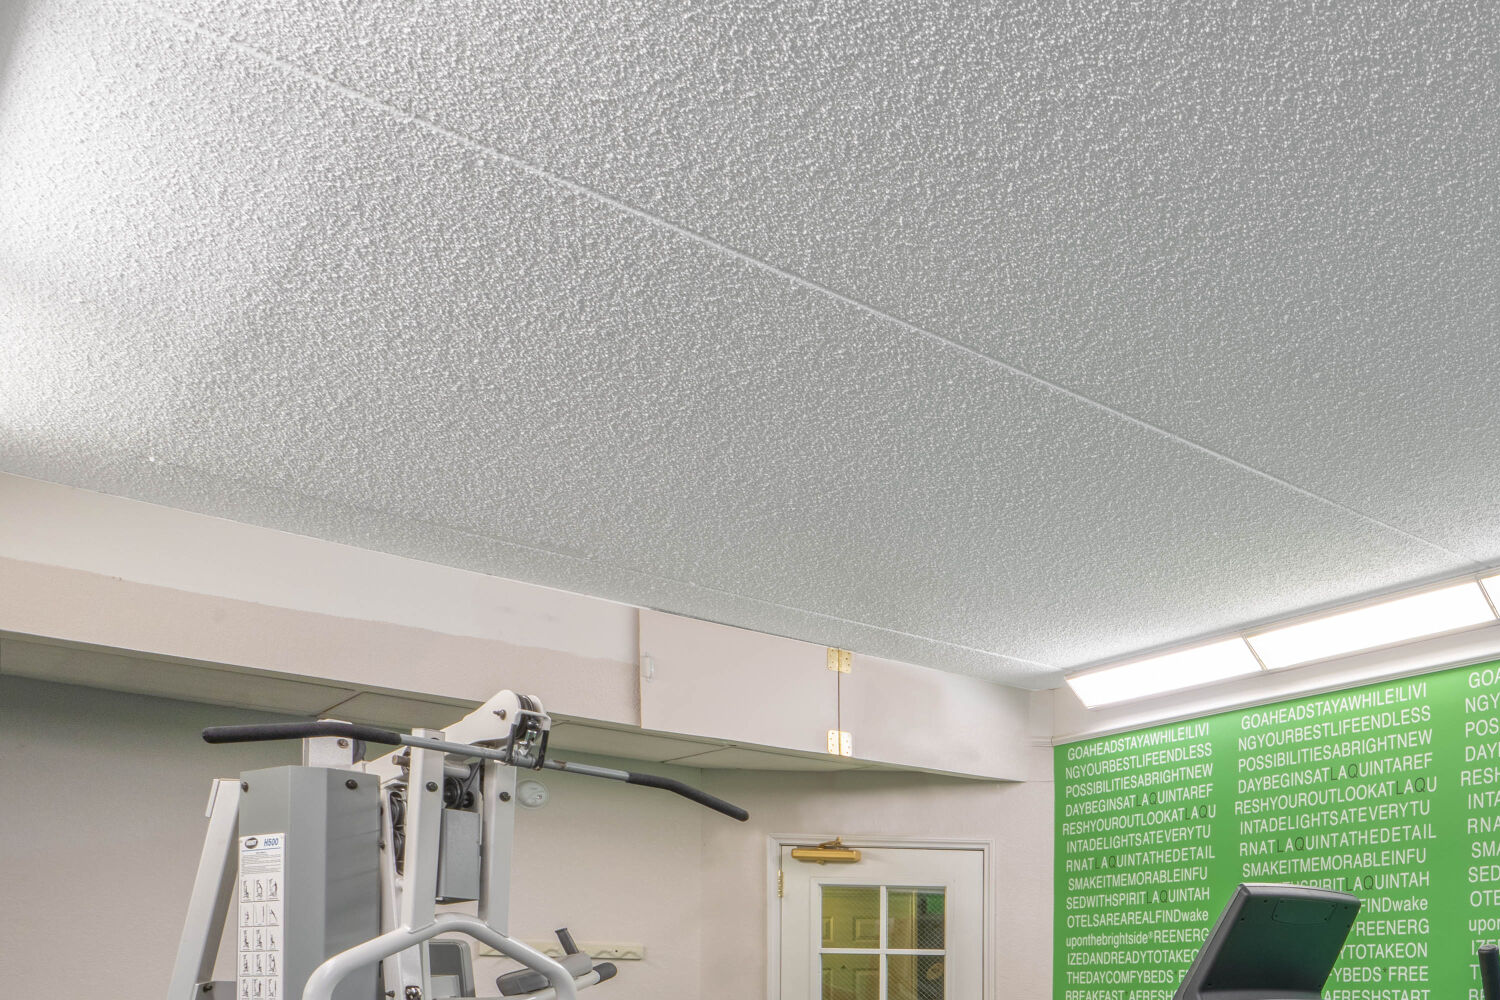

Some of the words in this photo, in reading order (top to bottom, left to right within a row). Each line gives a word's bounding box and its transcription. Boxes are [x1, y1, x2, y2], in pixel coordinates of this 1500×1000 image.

[1241, 681, 1426, 731] GOAHEADSTAYAWHILE!LIVI
[1238, 704, 1431, 753] NGYOURBESTLIFEENDLESS
[1238, 727, 1432, 774] POSSIBILITIESABRIGHTNEW
[1238, 751, 1432, 794] DAYBEGINSATLAQUINTAREF
[1235, 774, 1437, 816] RESHYOUROUTLOOKATLAQU
[1240, 799, 1430, 836] INTADELIGHTSATEVERYTU
[1240, 822, 1436, 857] RNATLAQUINTATHEDETAIL
[1243, 846, 1426, 878] SMAKEITMEMORABLEINFU
